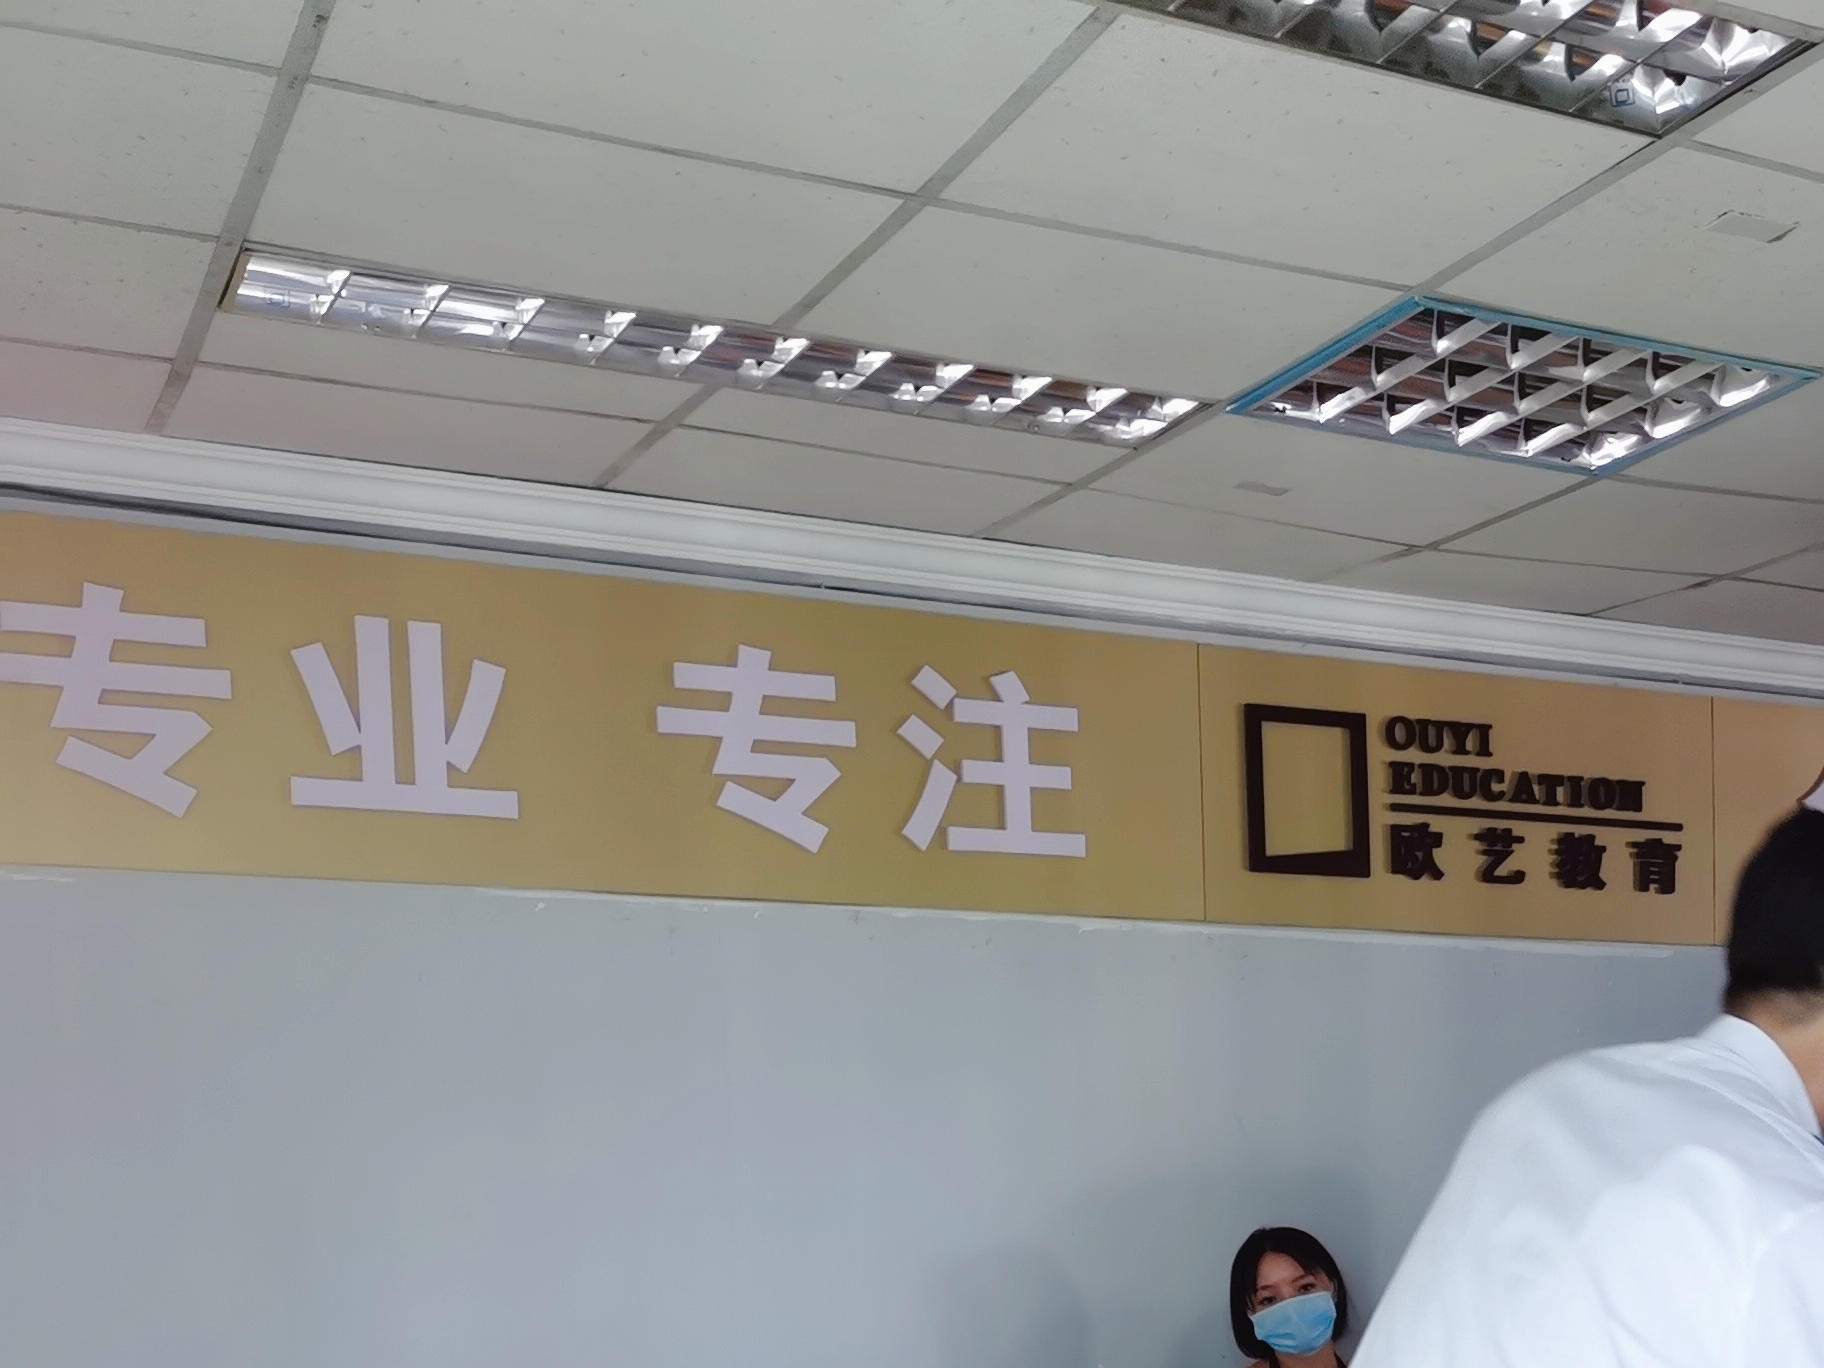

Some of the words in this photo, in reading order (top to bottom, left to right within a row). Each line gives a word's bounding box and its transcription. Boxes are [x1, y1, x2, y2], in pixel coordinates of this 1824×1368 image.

[0, 581, 519, 819] 专业
[656, 644, 1086, 858] 专注
[1384, 715, 1494, 758] OUYI
[1387, 761, 1647, 813] EDUCATION
[1388, 822, 1683, 895] 欧艺教育
